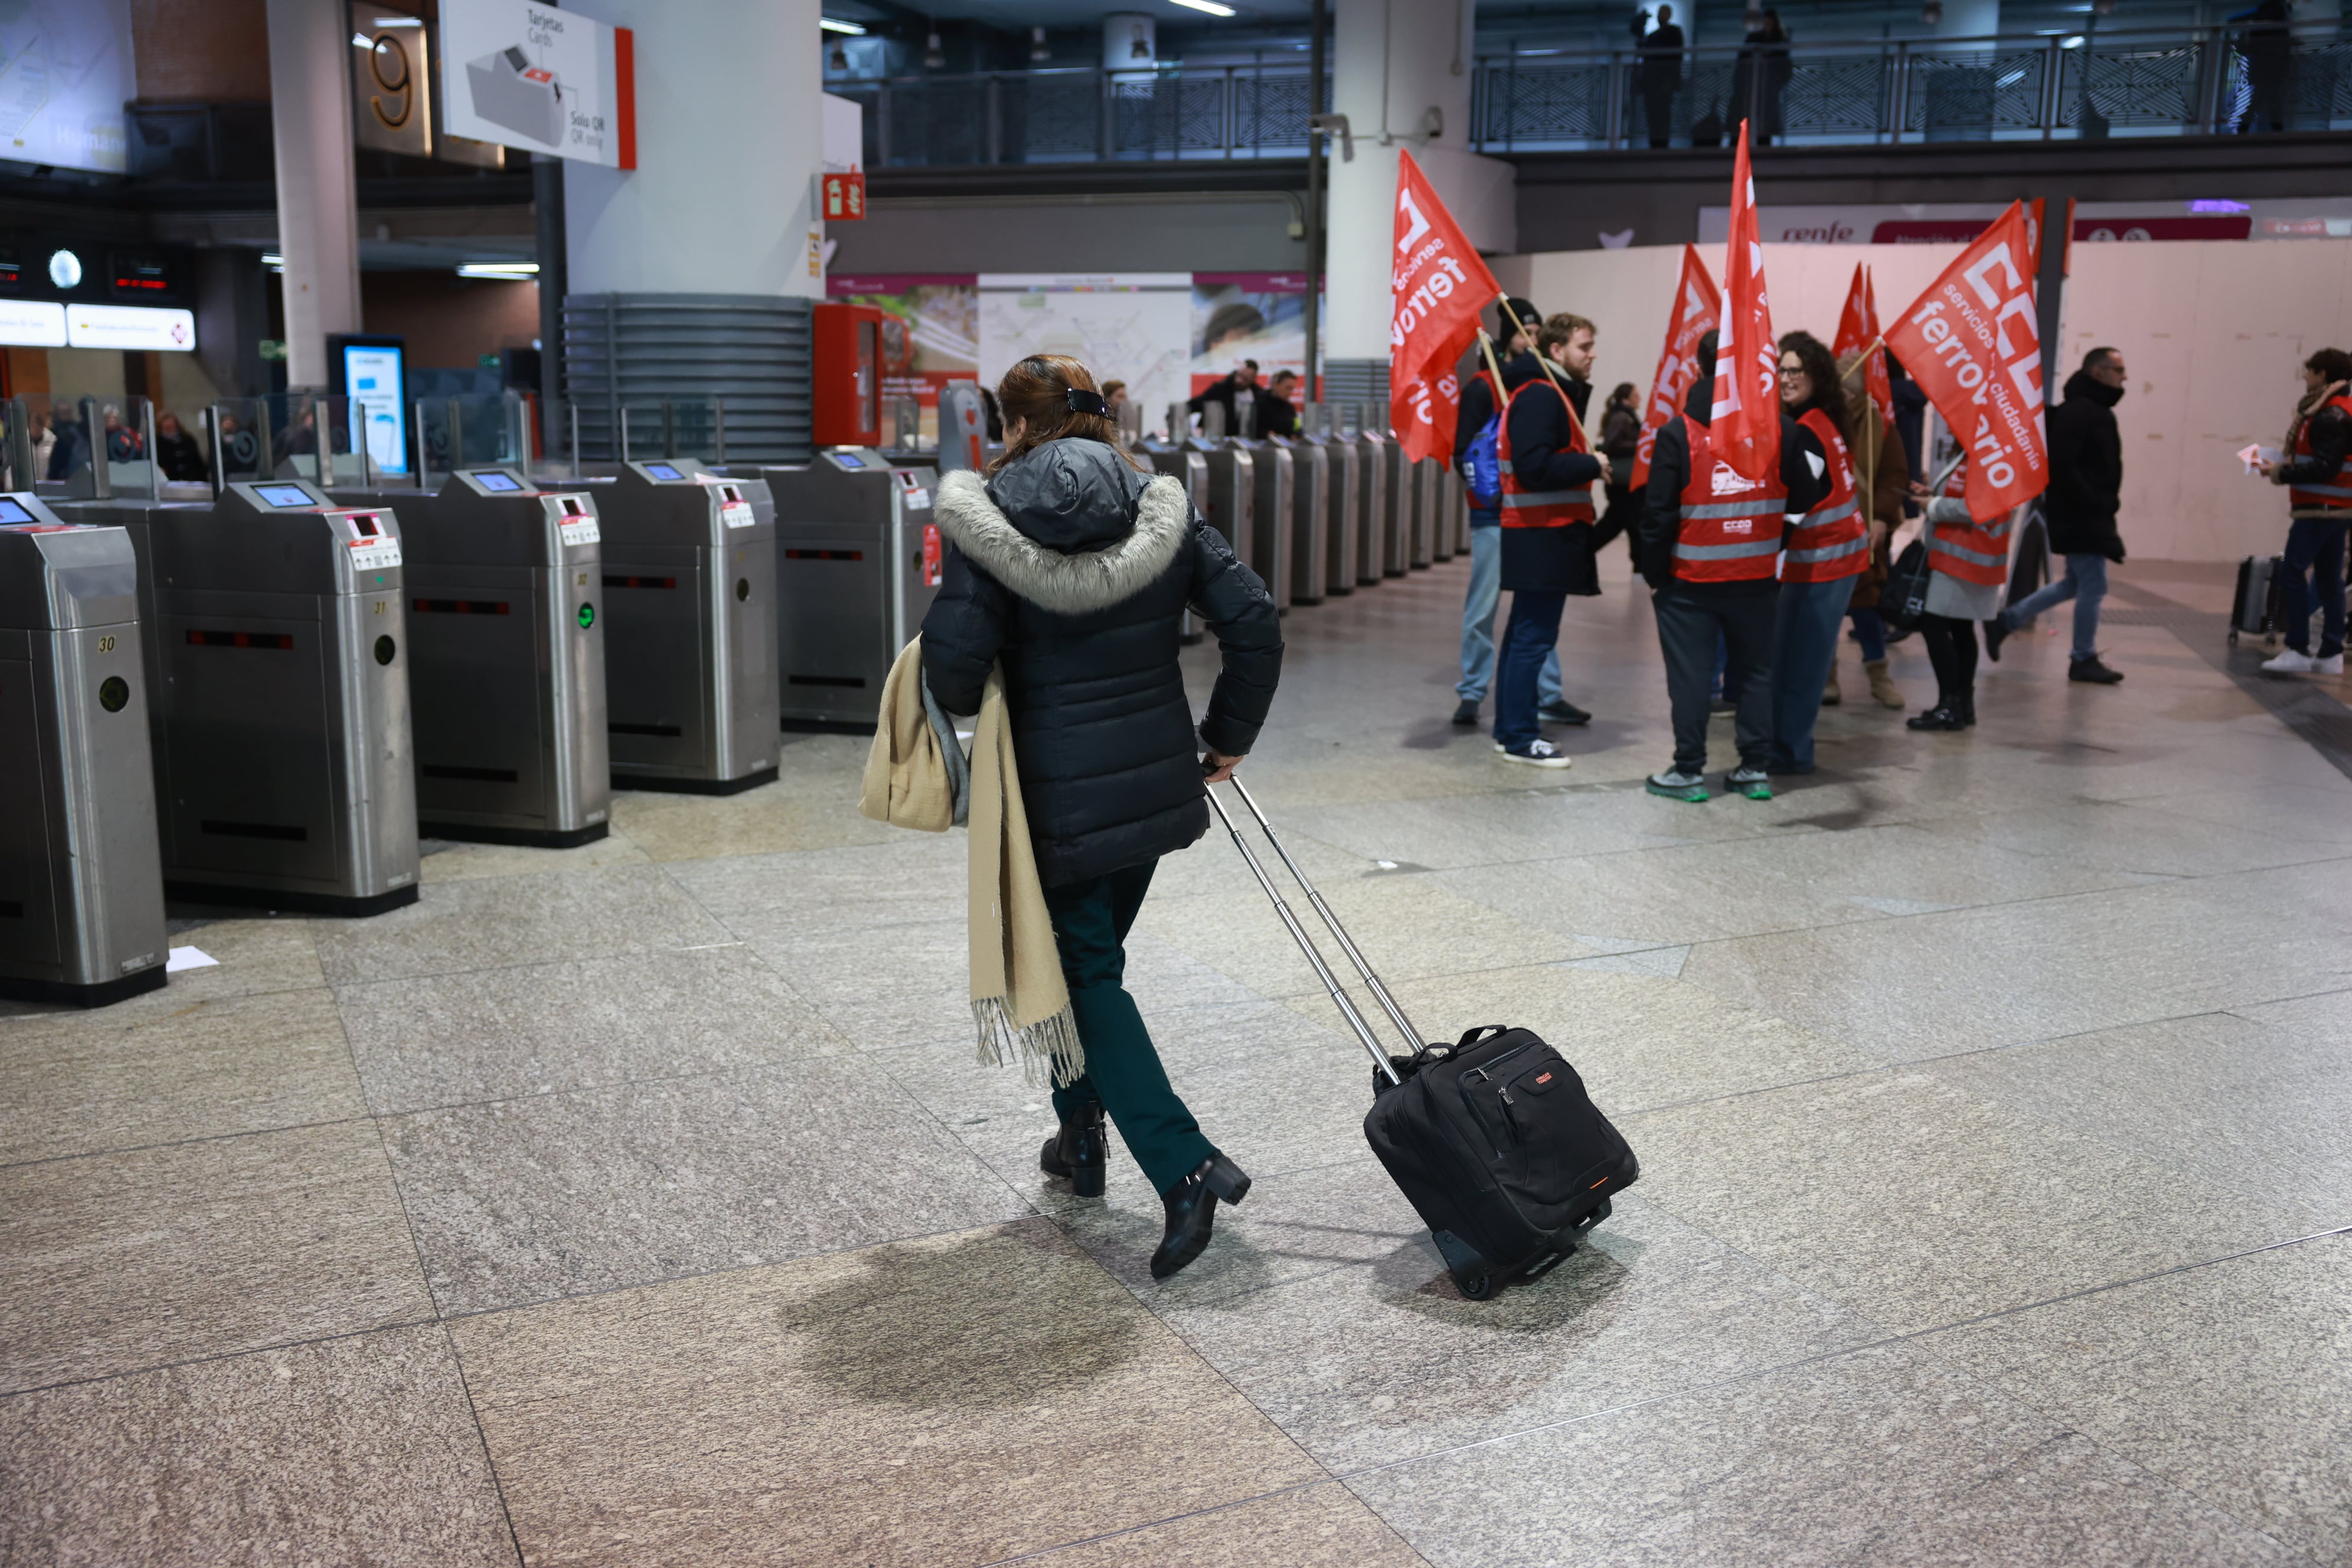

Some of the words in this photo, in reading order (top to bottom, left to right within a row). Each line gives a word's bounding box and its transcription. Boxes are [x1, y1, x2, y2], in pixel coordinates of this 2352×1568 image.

[527, 9, 564, 34] Tarjetas
[527, 27, 553, 47] Cards
[369, 31, 413, 131] 9
[570, 110, 590, 128] Solo
[592, 116, 605, 131] QR
[1782, 219, 1854, 243] renfe
[1943, 283, 1995, 349] servicios
[1990, 382, 2041, 472] ciudadanía
[99, 636, 115, 652] 30
